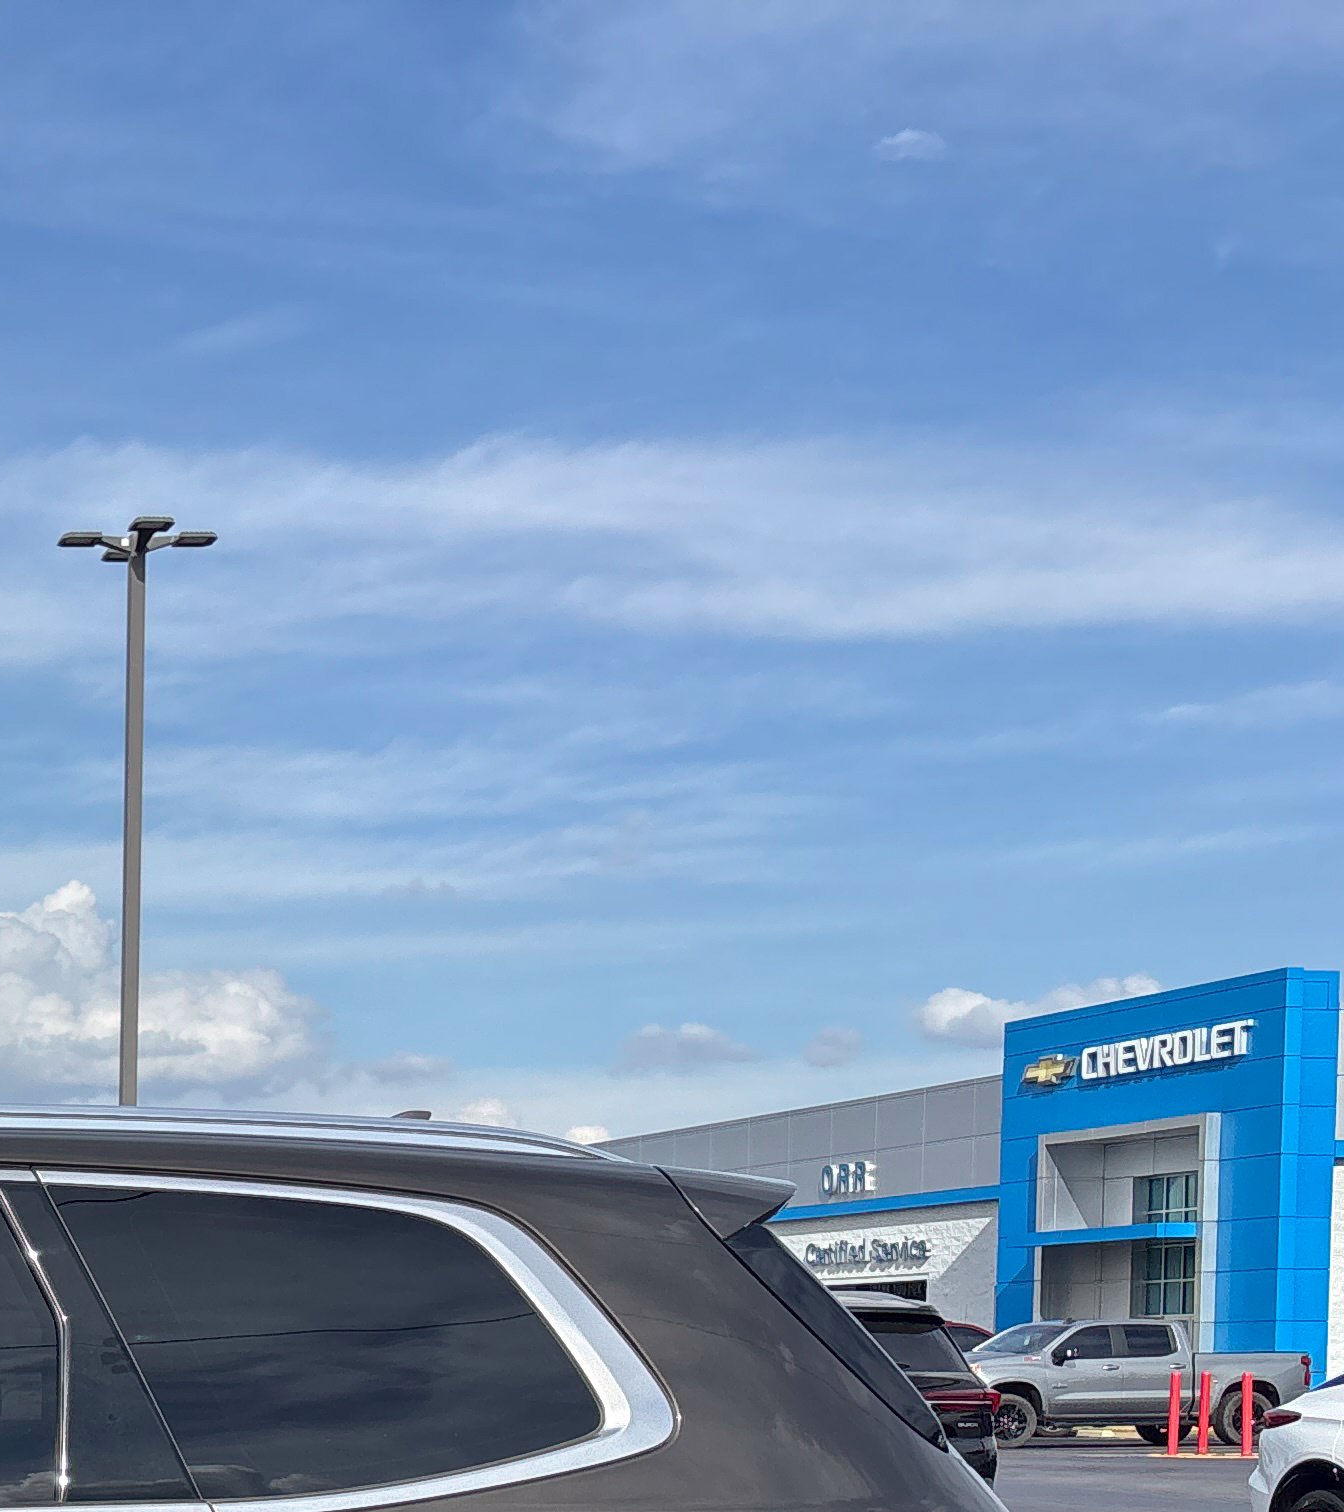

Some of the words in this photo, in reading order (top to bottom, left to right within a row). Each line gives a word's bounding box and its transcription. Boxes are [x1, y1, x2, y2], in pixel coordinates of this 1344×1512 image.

[1081, 1018, 1256, 1080] CHEVROLET
[805, 1239, 870, 1265] Certified
[871, 1236, 932, 1263] Service
